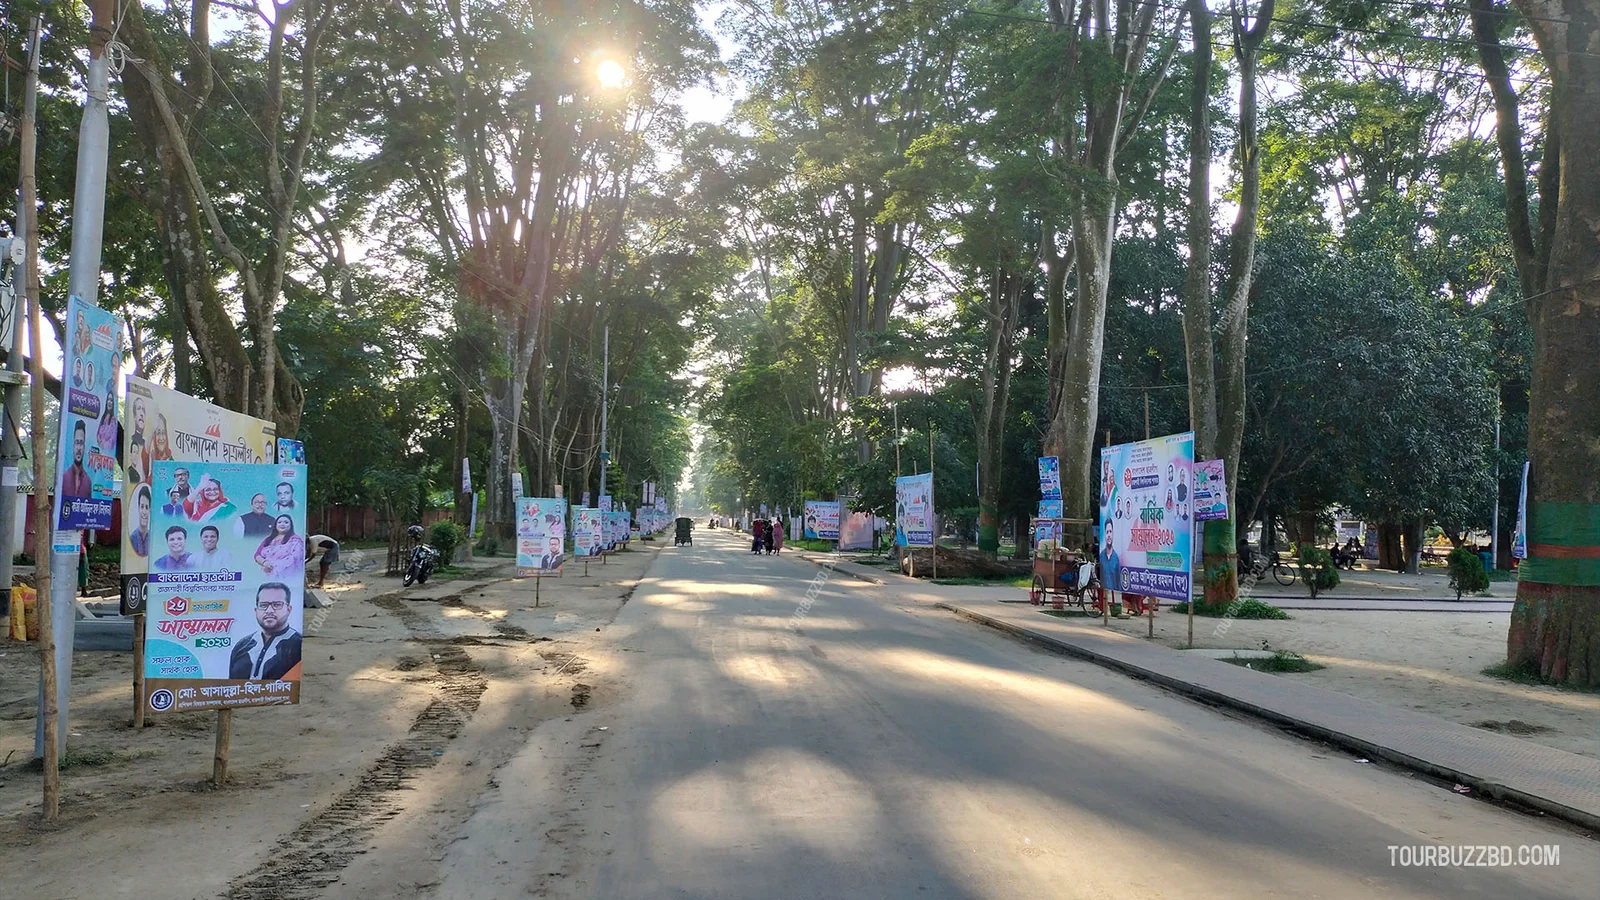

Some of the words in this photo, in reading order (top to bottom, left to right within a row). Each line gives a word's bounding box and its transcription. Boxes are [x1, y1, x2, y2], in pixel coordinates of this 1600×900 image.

[175, 430, 219, 461] বাংলাদেশ
[222, 437, 253, 463] ছাত্রলীগ
[1140, 500, 1164, 524] বার্ষিক
[157, 571, 200, 583] বাংলাদেশ
[200, 568, 236, 583] ছাত্রলীগ
[157, 584, 182, 594] রাজশাহী
[182, 584, 218, 594] বিশ্ববিদ্যালয়
[156, 617, 235, 640] সম্মেলন
[199, 637, 231, 649] ২০২৩
[151, 656, 172, 665] সফল
[173, 655, 192, 665] হোক
[160, 665, 181, 675] সার্থক
[182, 664, 200, 674] হোক
